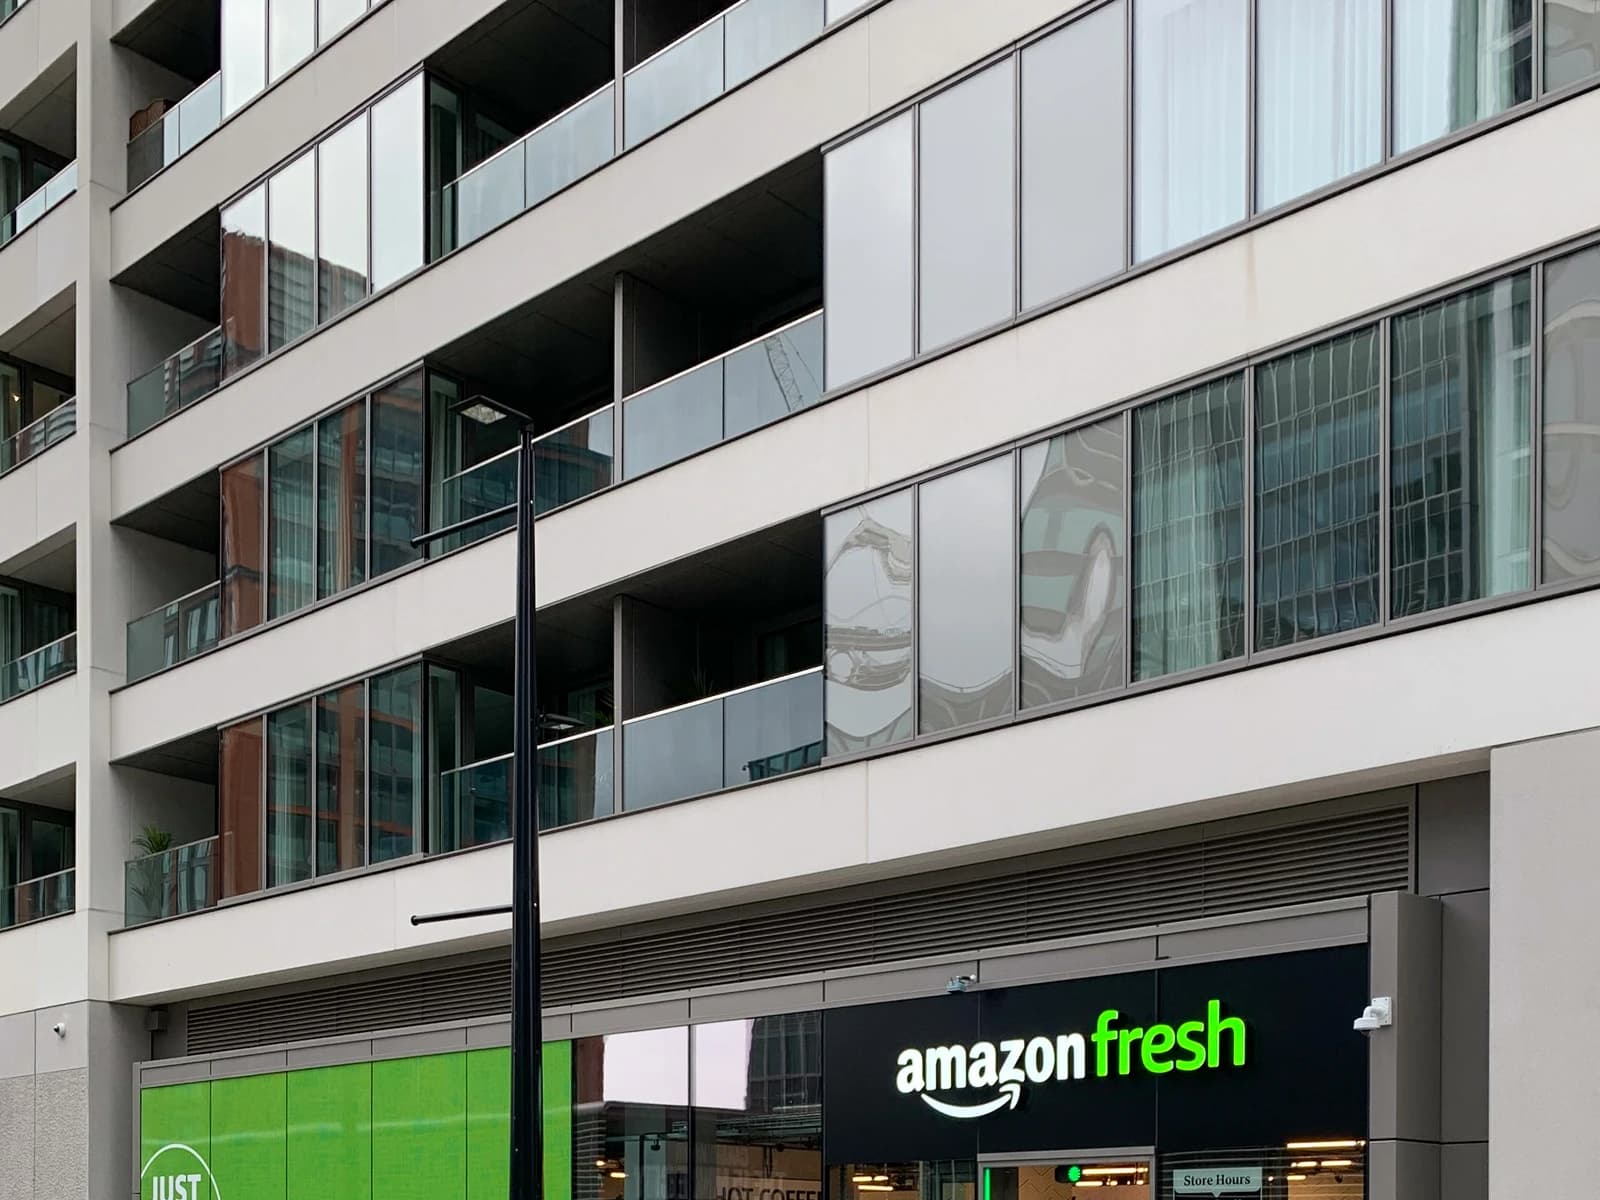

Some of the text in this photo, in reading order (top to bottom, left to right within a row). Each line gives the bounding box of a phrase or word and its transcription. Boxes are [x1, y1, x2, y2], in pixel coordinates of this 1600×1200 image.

[896, 999, 1245, 1098] amazon fresh
[1183, 1173, 1251, 1187] Store Hours
